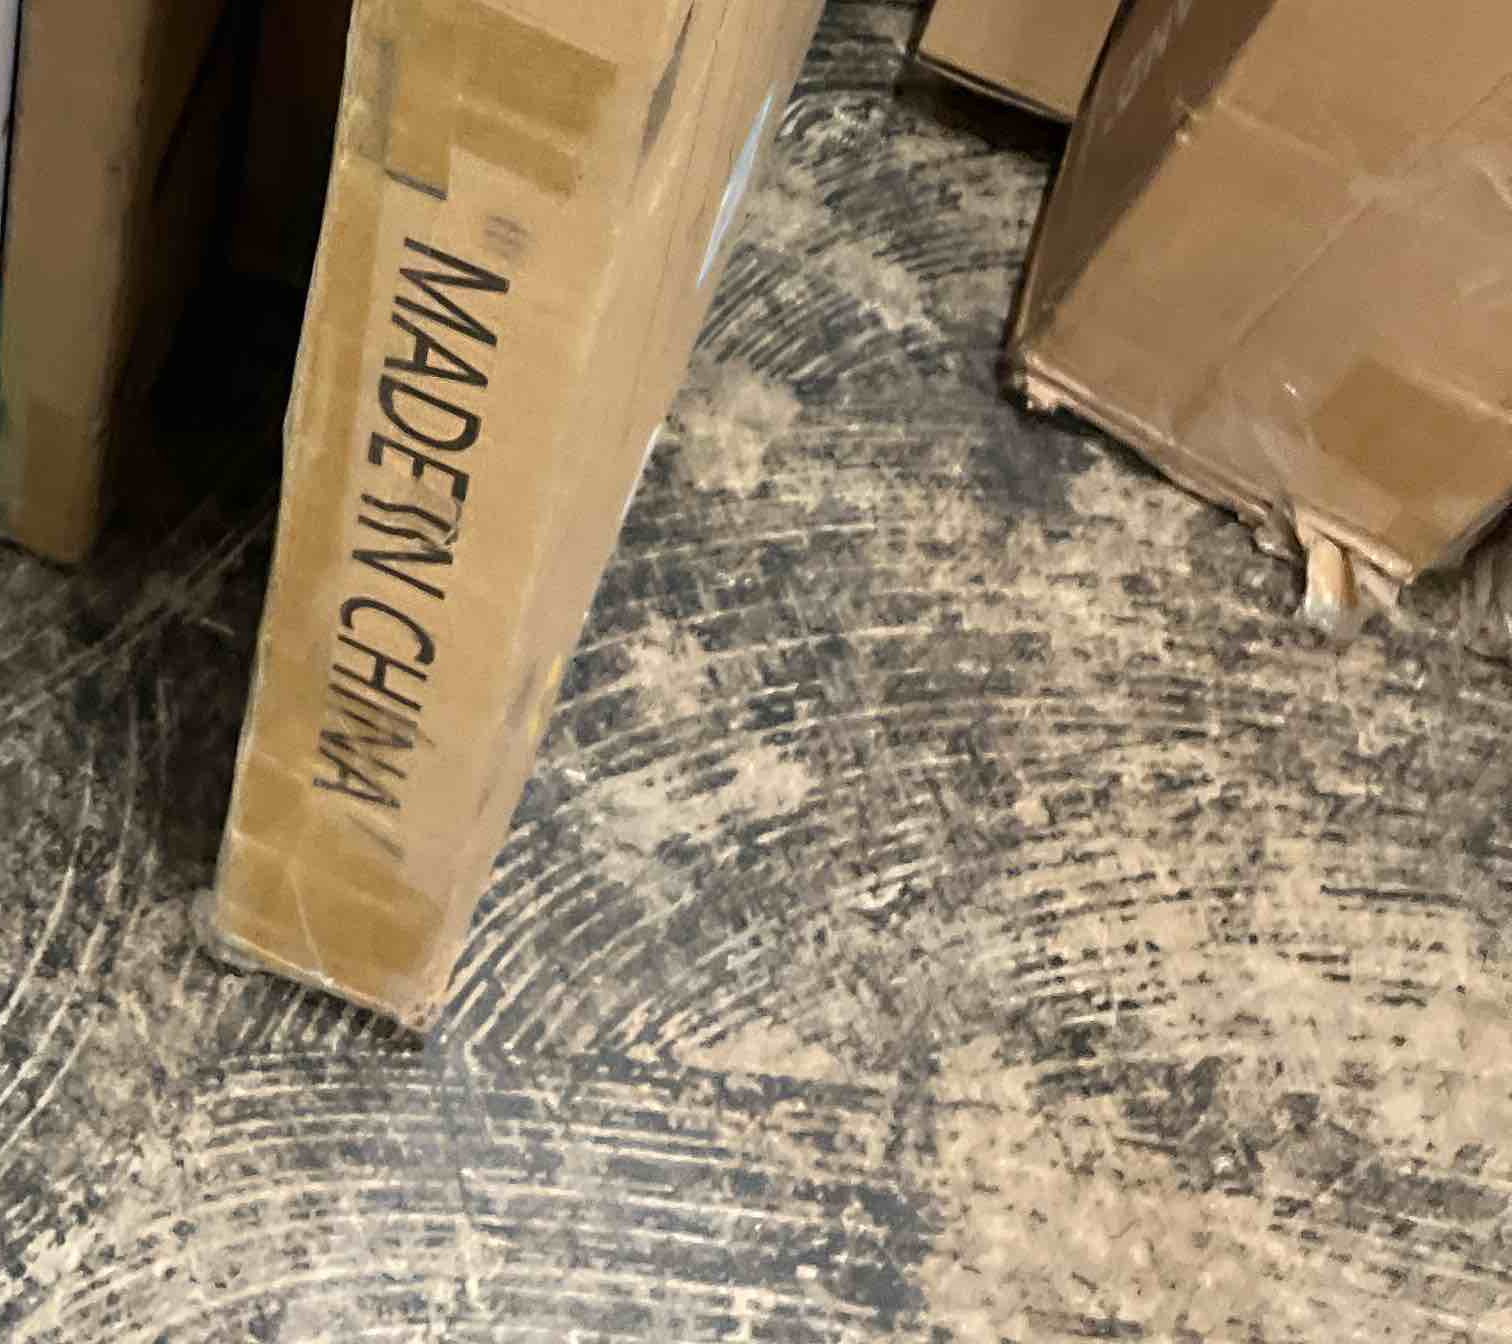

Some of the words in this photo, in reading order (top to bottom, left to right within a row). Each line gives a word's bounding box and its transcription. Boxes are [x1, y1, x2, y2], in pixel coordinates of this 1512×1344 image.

[367, 236, 511, 505] MADE
[350, 491, 463, 600] IN
[312, 595, 437, 812] CHINA
